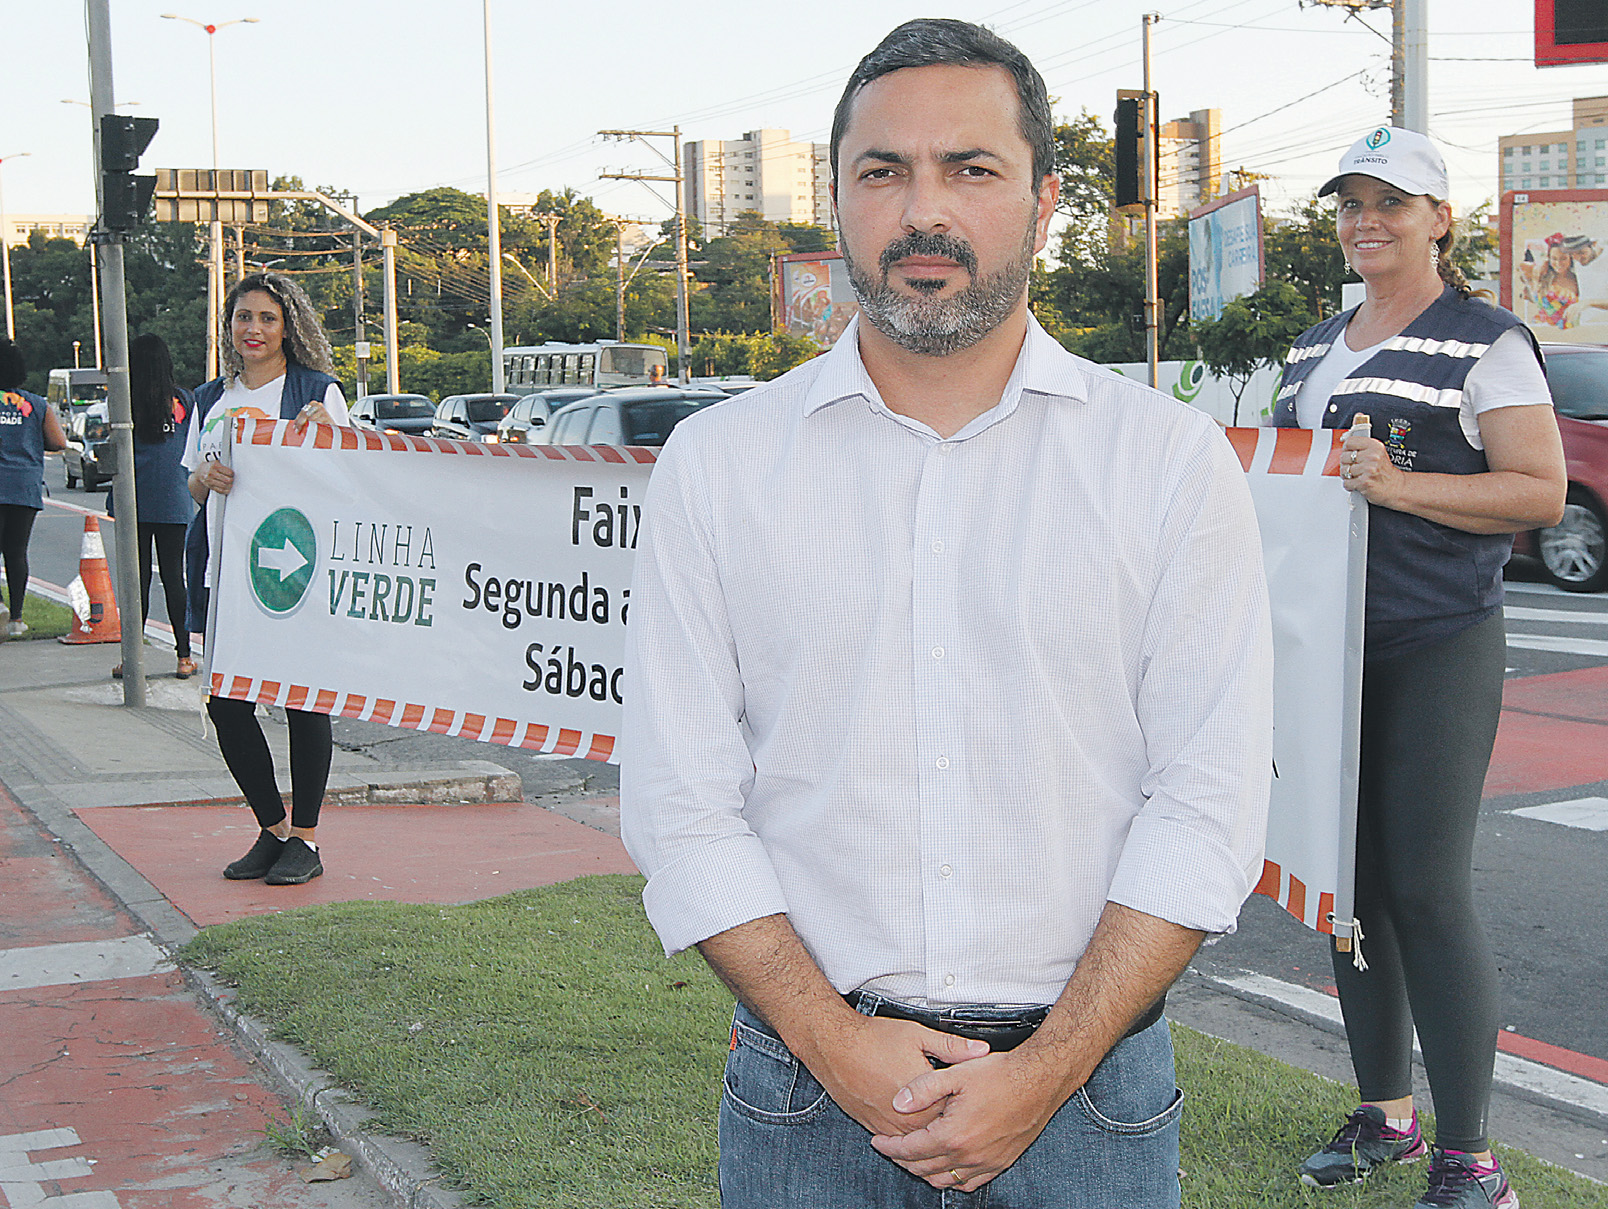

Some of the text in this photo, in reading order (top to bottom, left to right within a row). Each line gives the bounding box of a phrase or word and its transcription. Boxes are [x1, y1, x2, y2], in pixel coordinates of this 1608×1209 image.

[0, 417, 23, 425] DADE
[330, 520, 436, 569] LINHA
[328, 569, 436, 627] VERDE
[462, 562, 610, 630] Segunda
